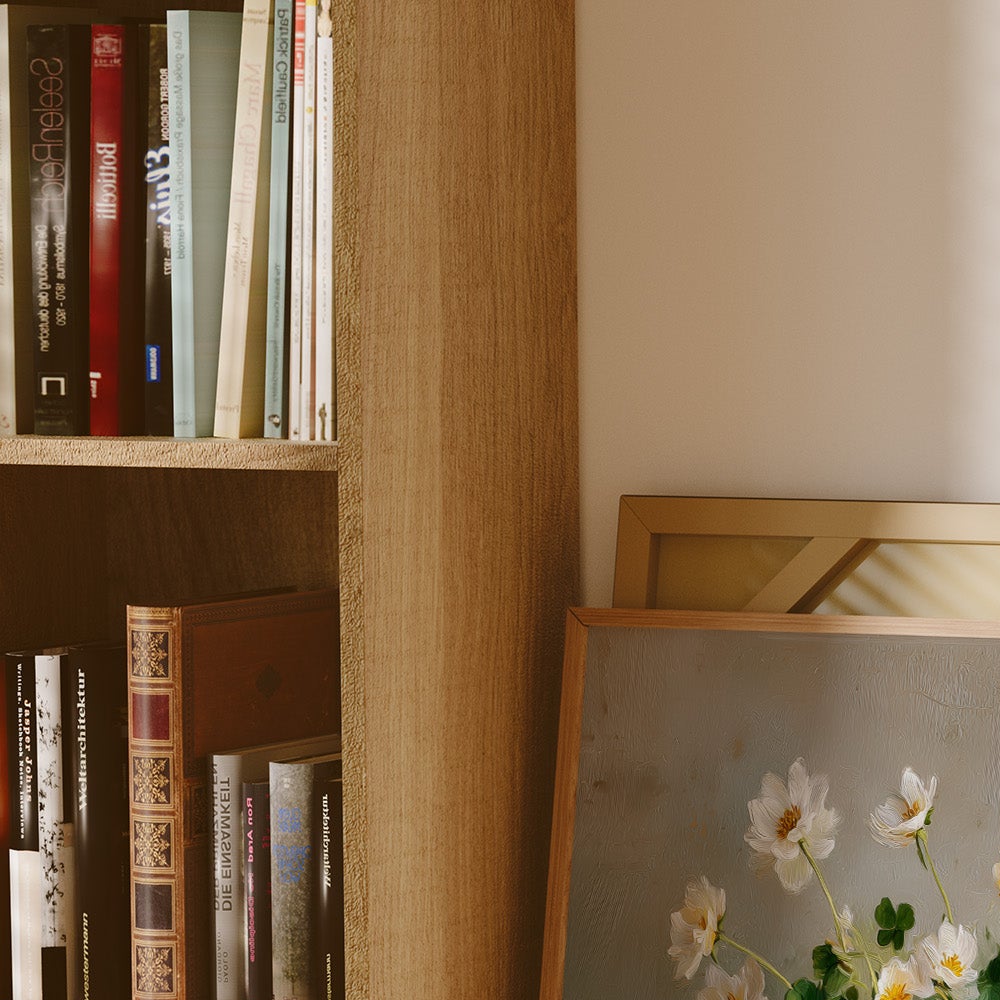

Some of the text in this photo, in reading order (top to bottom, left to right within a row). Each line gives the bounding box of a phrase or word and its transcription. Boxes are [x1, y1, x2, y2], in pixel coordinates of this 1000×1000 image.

[23, 700, 33, 802] Jasper Johns
[77, 668, 87, 810] Weltarchitektur
